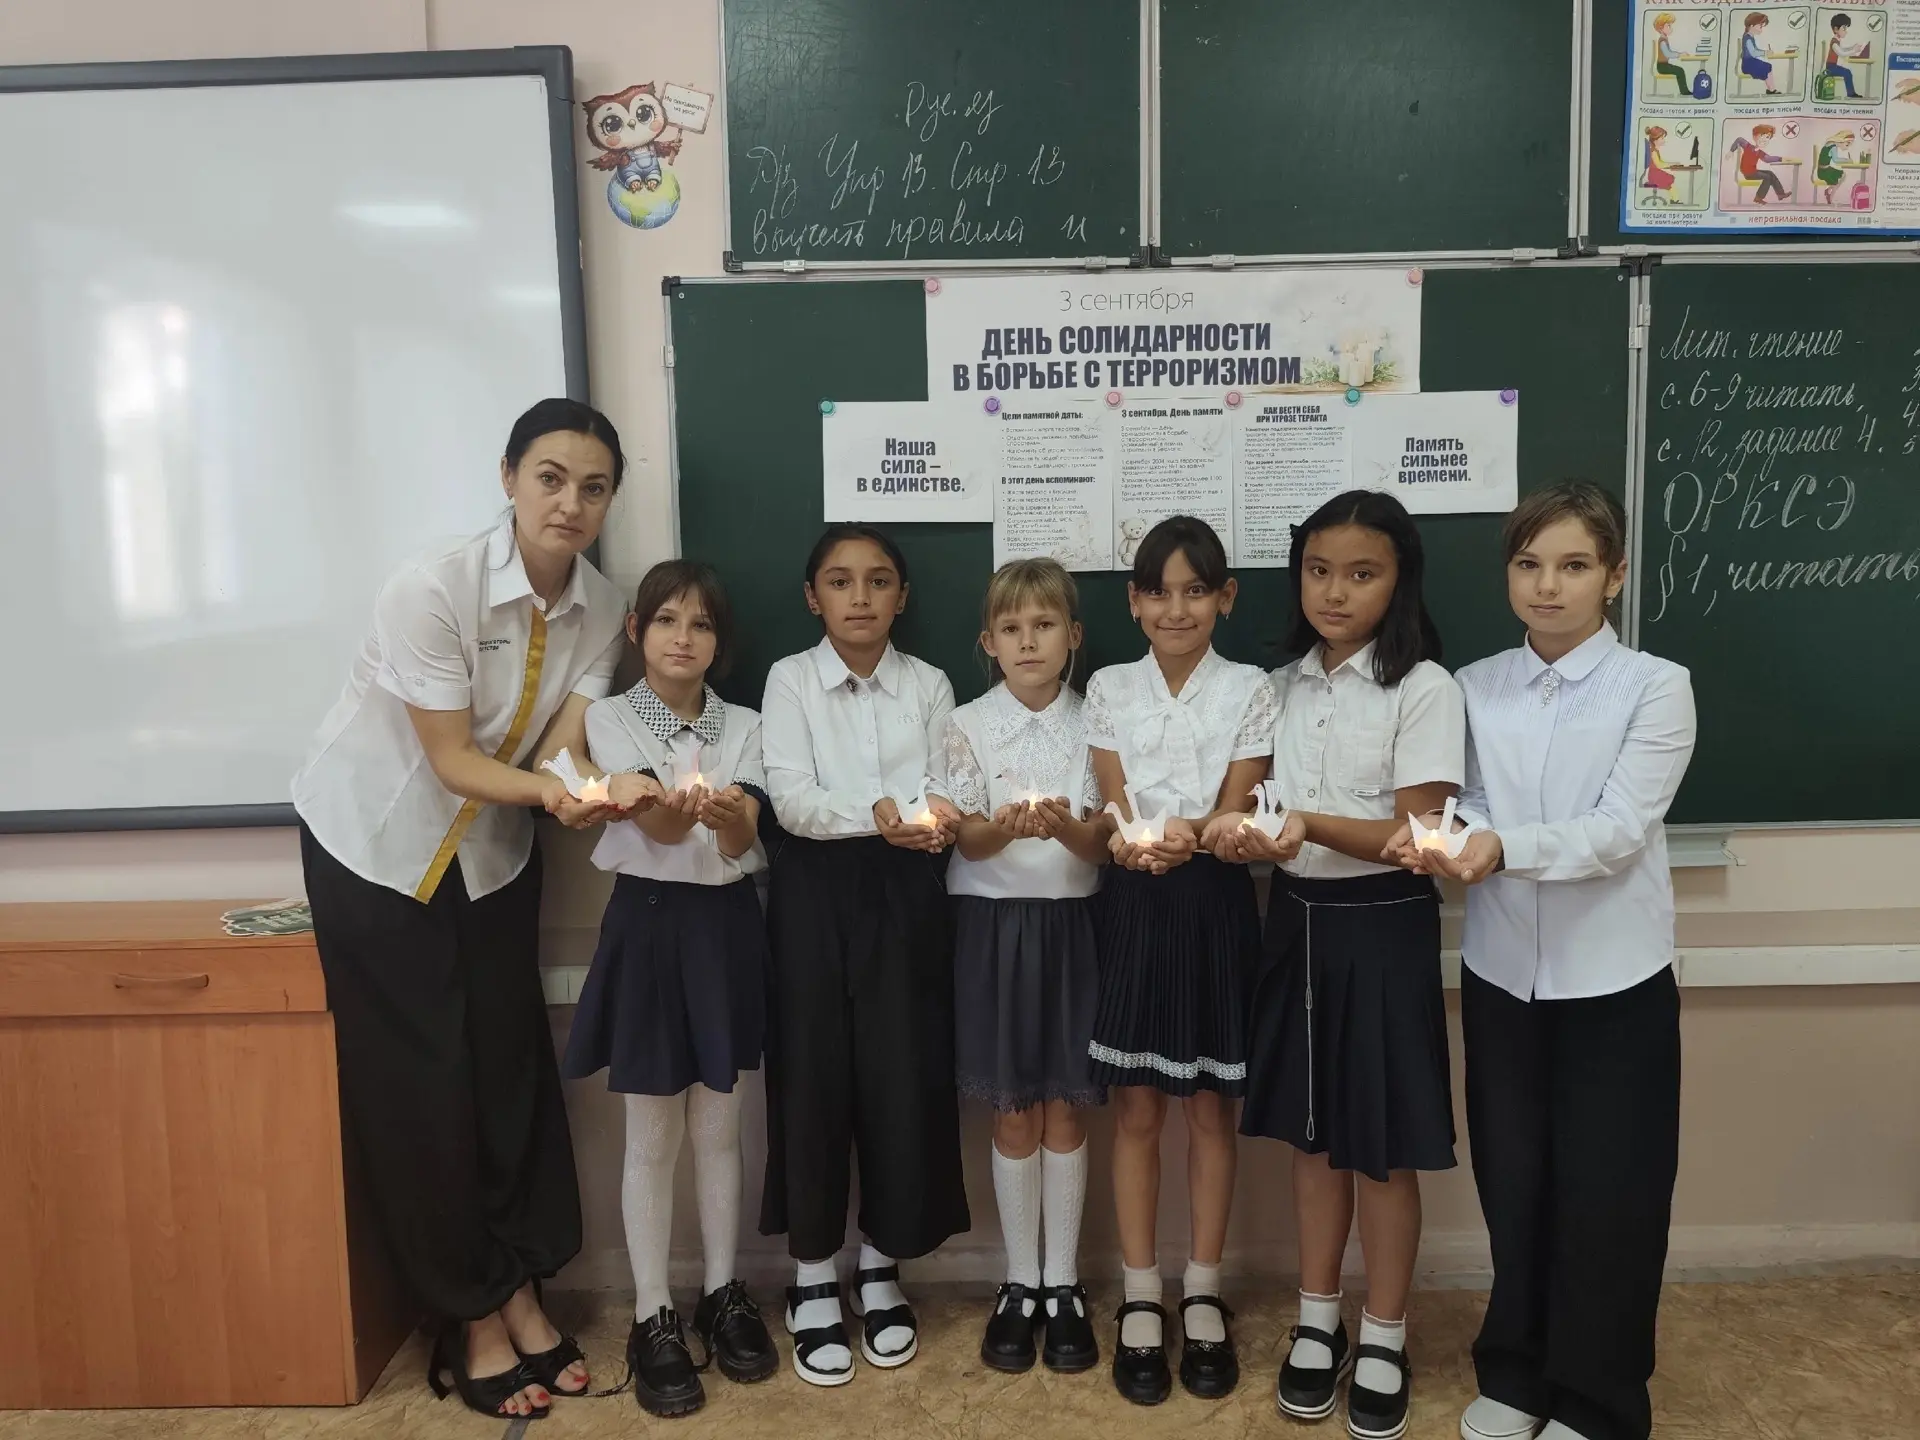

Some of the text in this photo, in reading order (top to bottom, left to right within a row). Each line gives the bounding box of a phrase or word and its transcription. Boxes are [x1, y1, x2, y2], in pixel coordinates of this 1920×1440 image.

[1748, 215, 1842, 225] неправильная посадка
[1059, 287, 1195, 314] 3 сентября
[981, 323, 1272, 361] ДЕНЬ СОЛИДАРНОСТИ
[952, 356, 1302, 392] В БОРЬБЕ С ТЕРРОРИЗМОМ
[1001, 411, 1084, 421] Цели памятной даты:
[1121, 409, 1127, 418] 3
[1170, 408, 1191, 418] День
[1192, 408, 1223, 416] памяти
[1263, 405, 1321, 415] КАК ВЕСТИ СЕБЯ
[1256, 414, 1328, 423] ПРИ УГРОЗЕ ТЕРАКТА
[885, 437, 937, 457] Наша
[1405, 437, 1465, 453] Память
[880, 459, 927, 475] сила
[1401, 453, 1469, 468] сильнее
[1001, 477, 1006, 485] В
[1025, 477, 1045, 485] день
[1046, 476, 1096, 484] вспоминают:
[1398, 469, 1472, 485] времени.
[856, 477, 966, 495] в единстве.
[1663, 471, 1856, 535] ОРКСЭ
